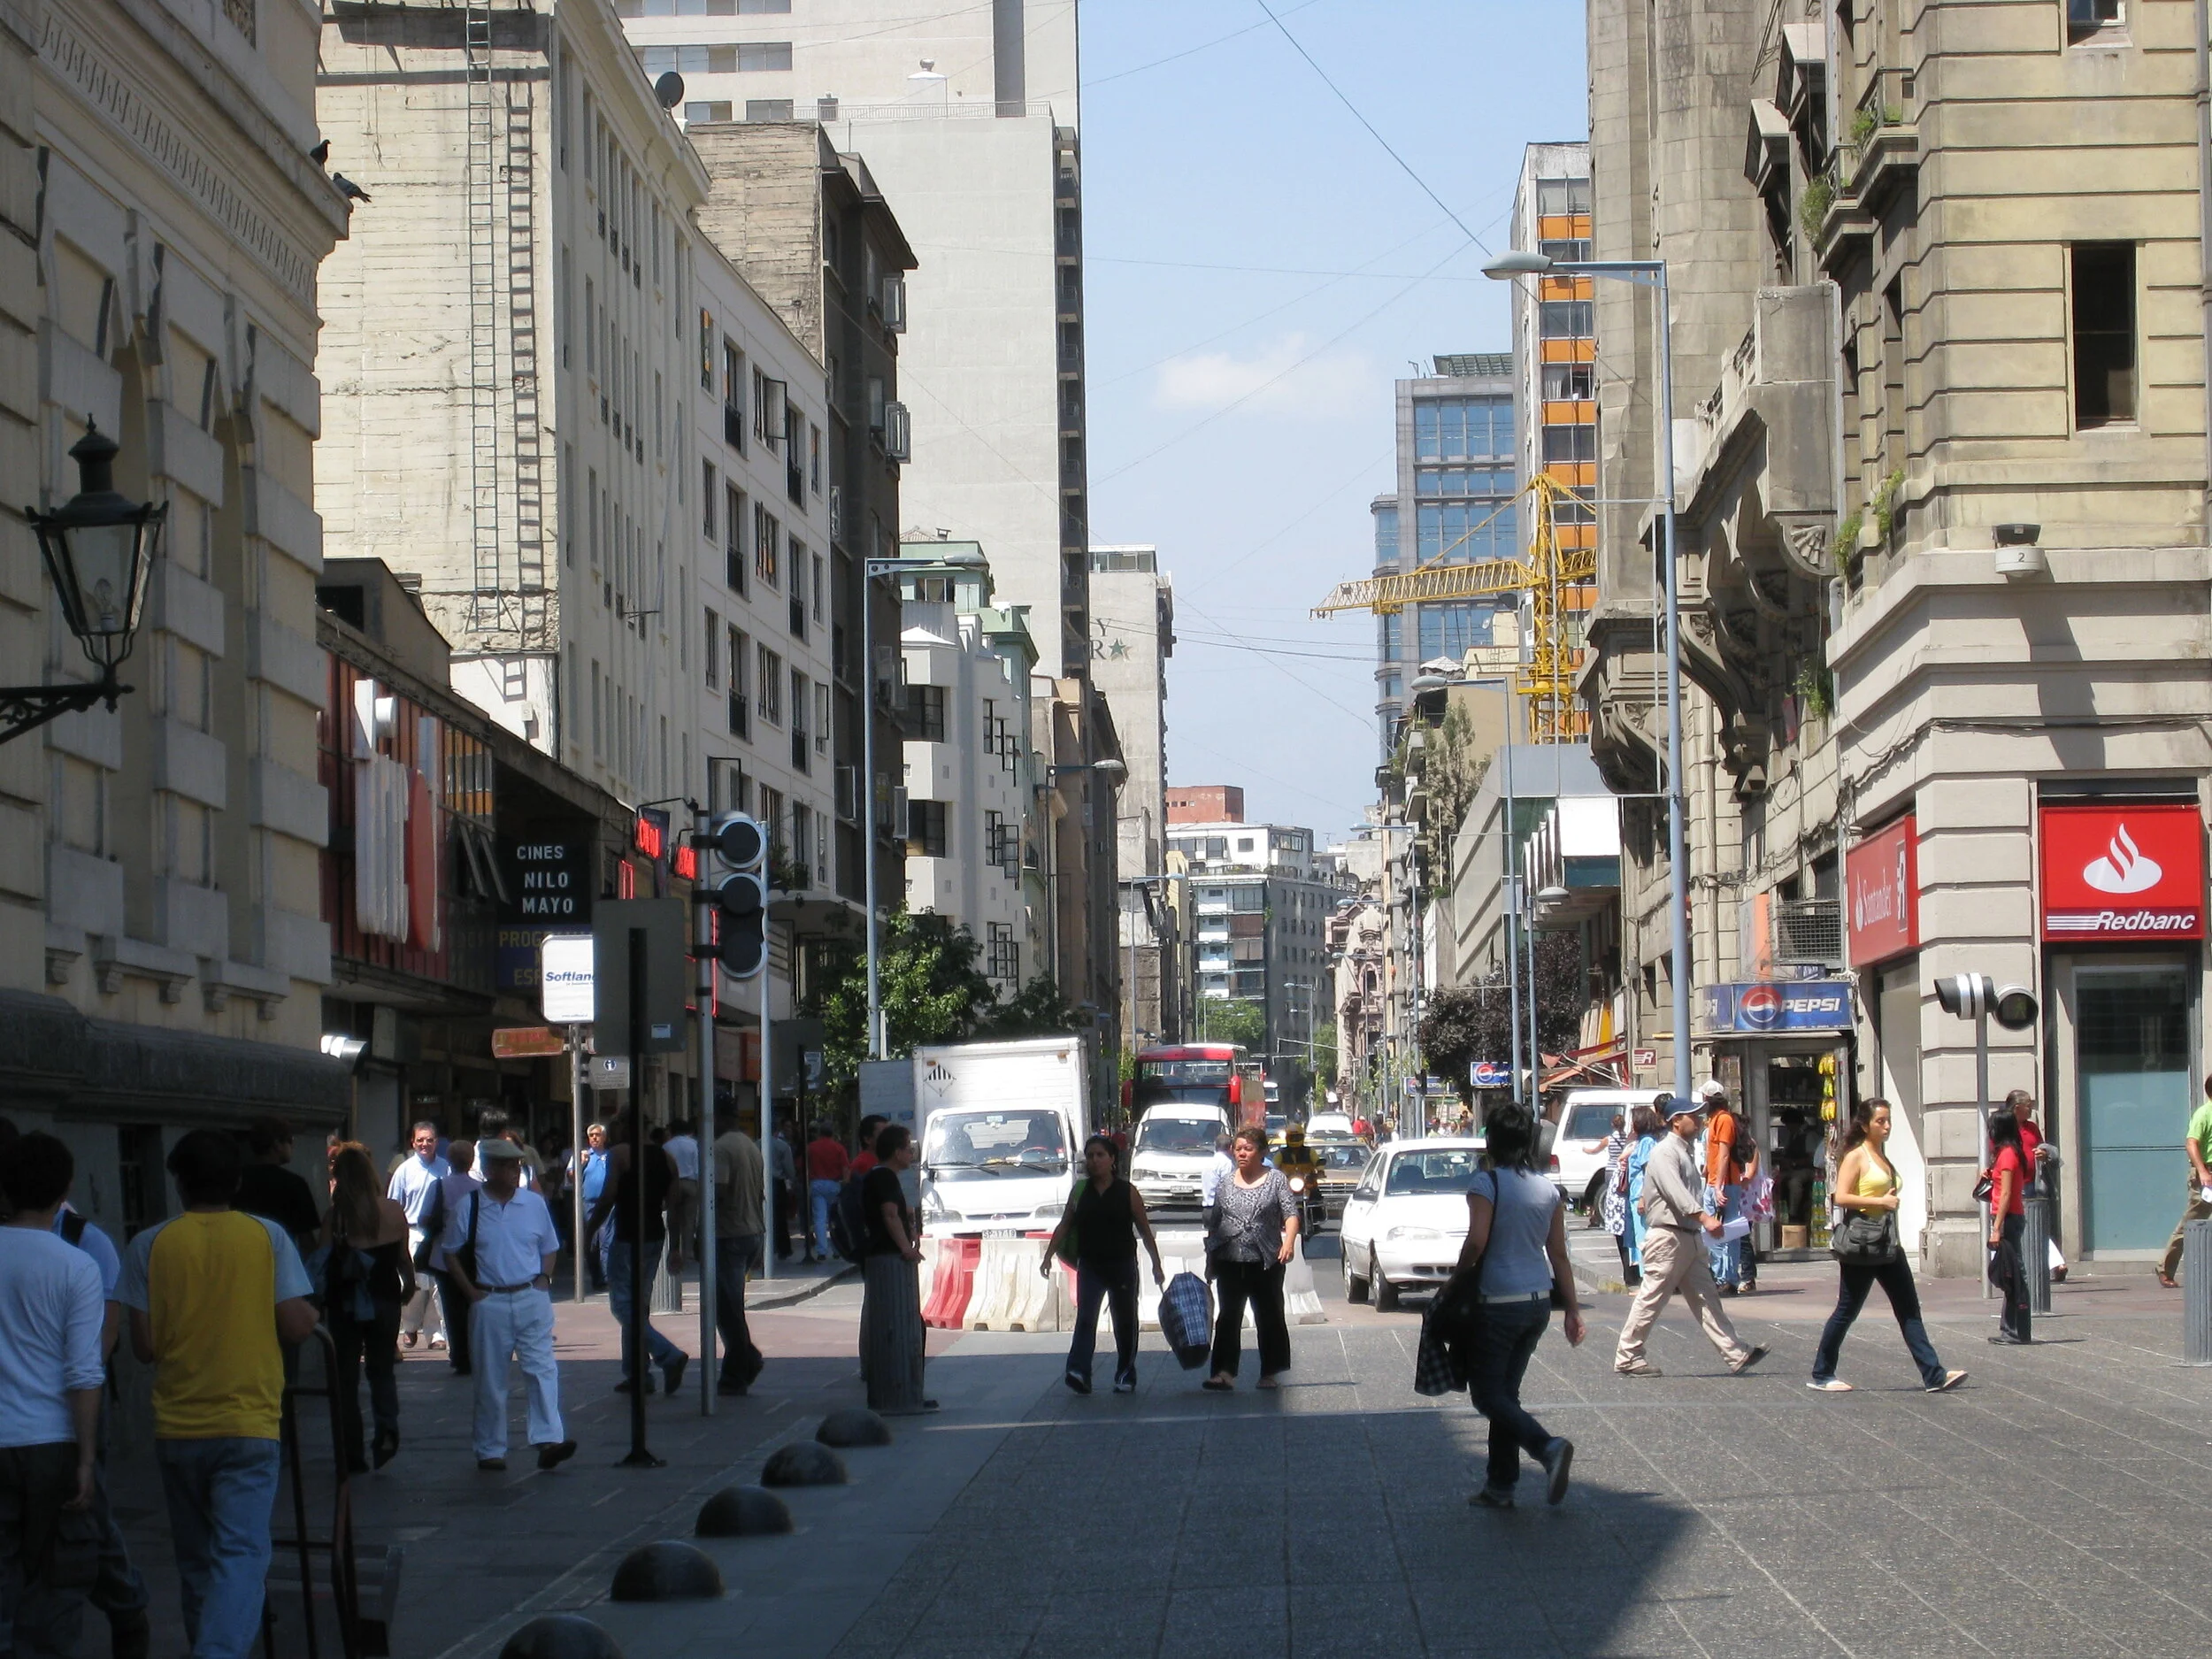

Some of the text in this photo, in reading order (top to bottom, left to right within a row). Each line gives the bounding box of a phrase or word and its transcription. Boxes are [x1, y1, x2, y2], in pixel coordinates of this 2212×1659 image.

[2018, 552, 2025, 563] 2
[1089, 639, 1107, 660] R
[517, 845, 564, 860] CINES
[524, 872, 569, 888] NILO
[522, 896, 574, 914] MAYO
[2095, 910, 2196, 930] Redbanc
[1781, 997, 1841, 1013] PEPSI
